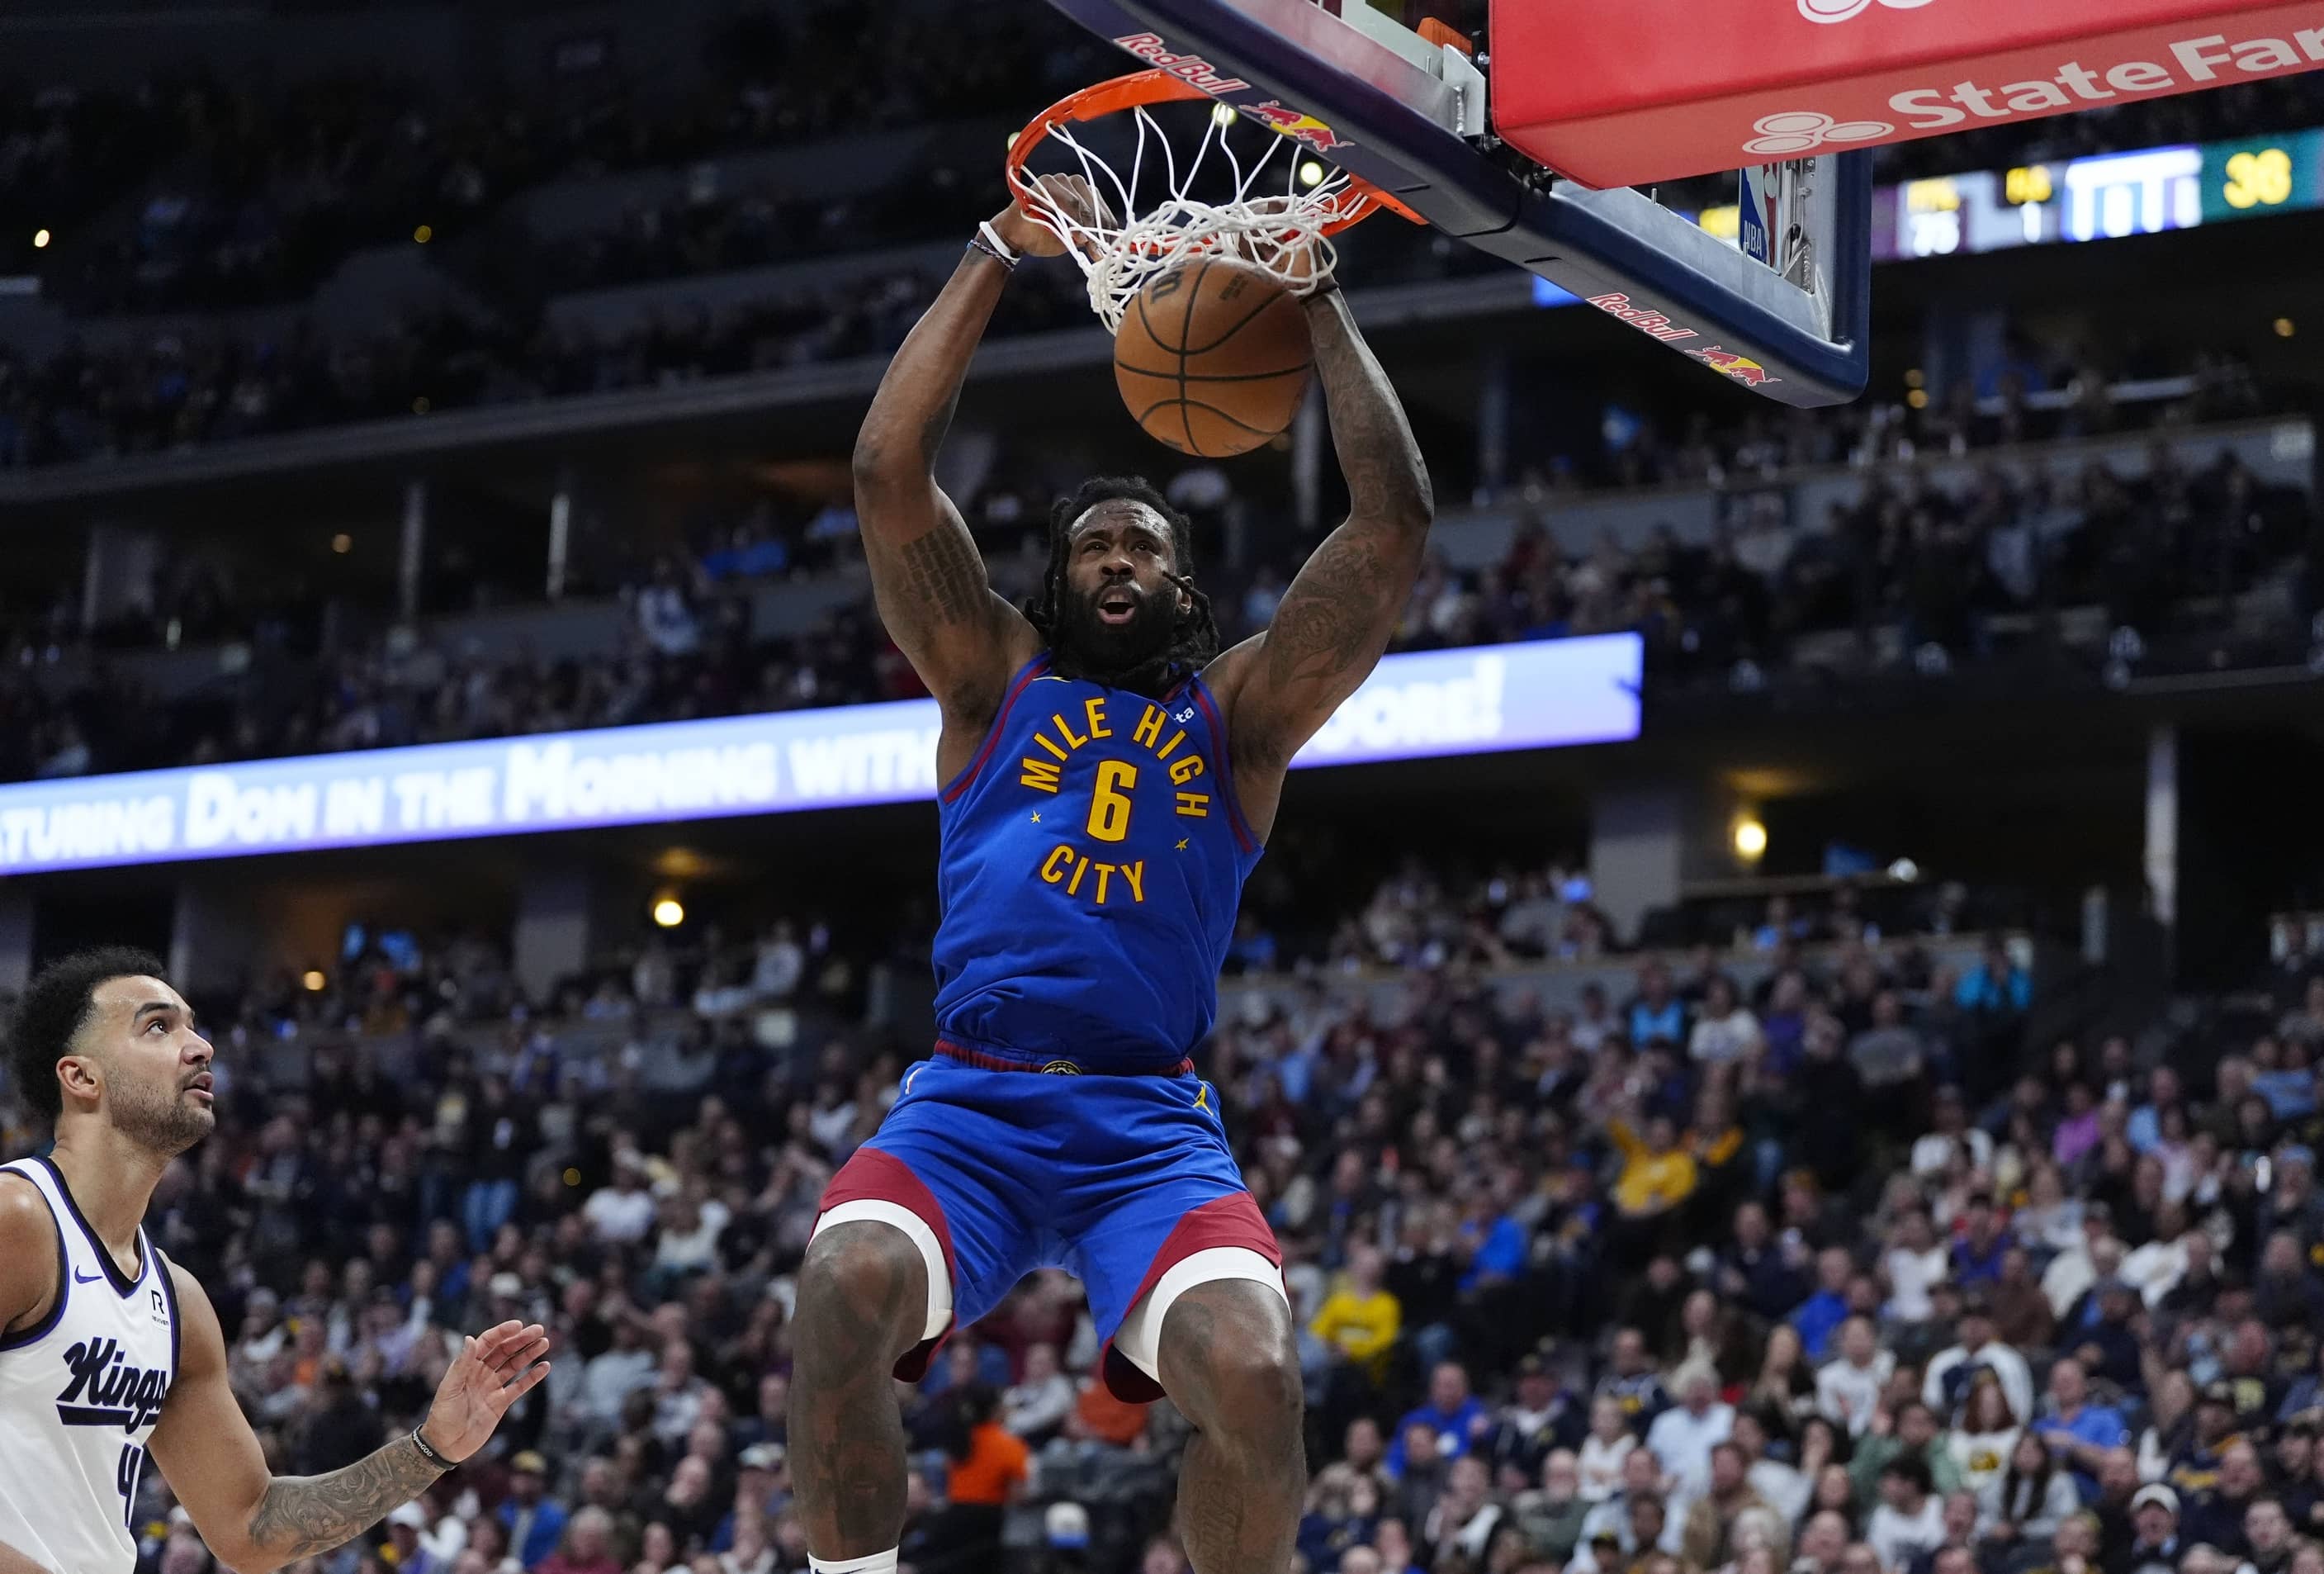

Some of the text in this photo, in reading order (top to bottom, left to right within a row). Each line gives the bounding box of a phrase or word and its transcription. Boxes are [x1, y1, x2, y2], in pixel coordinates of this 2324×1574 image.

[2169, 27, 2324, 82] Far
[1744, 219, 1763, 257] NBA
[1174, 706, 1195, 723] ta
[1020, 697, 1210, 818] MILE HIGH
[324, 775, 386, 837] IN
[1086, 759, 1138, 842] 6
[1040, 844, 1144, 905] CITY
[151, 1289, 165, 1315] R
